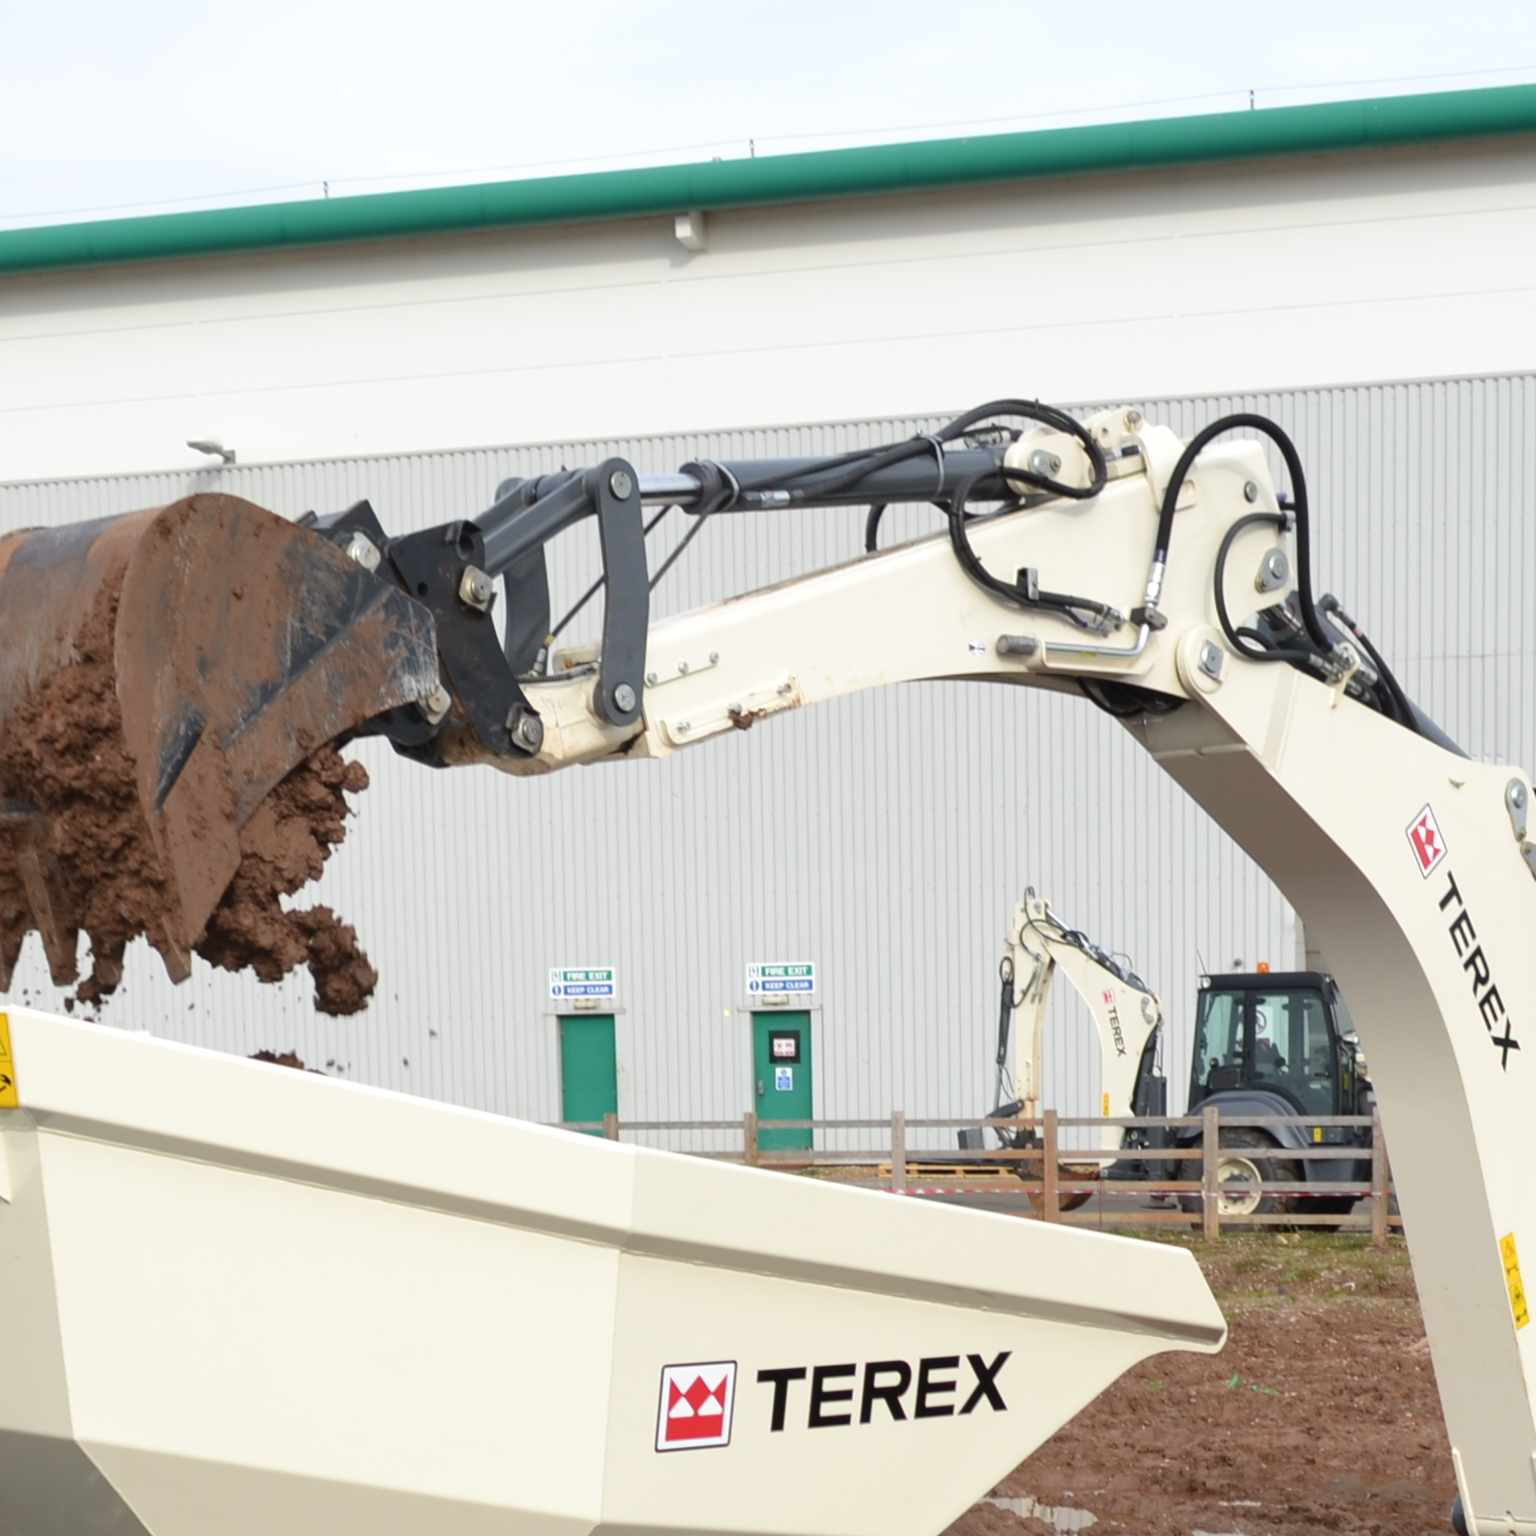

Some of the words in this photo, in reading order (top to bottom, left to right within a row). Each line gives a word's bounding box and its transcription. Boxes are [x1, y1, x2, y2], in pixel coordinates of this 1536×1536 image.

[567, 972, 585, 981] FIRE
[589, 971, 608, 980] EXIT
[765, 967, 784, 976] FIRE
[788, 966, 807, 975] EXIT
[1438, 870, 1521, 1073] TEREX
[1107, 1005, 1127, 1058] TEREX
[757, 1351, 1013, 1432] TEREX
